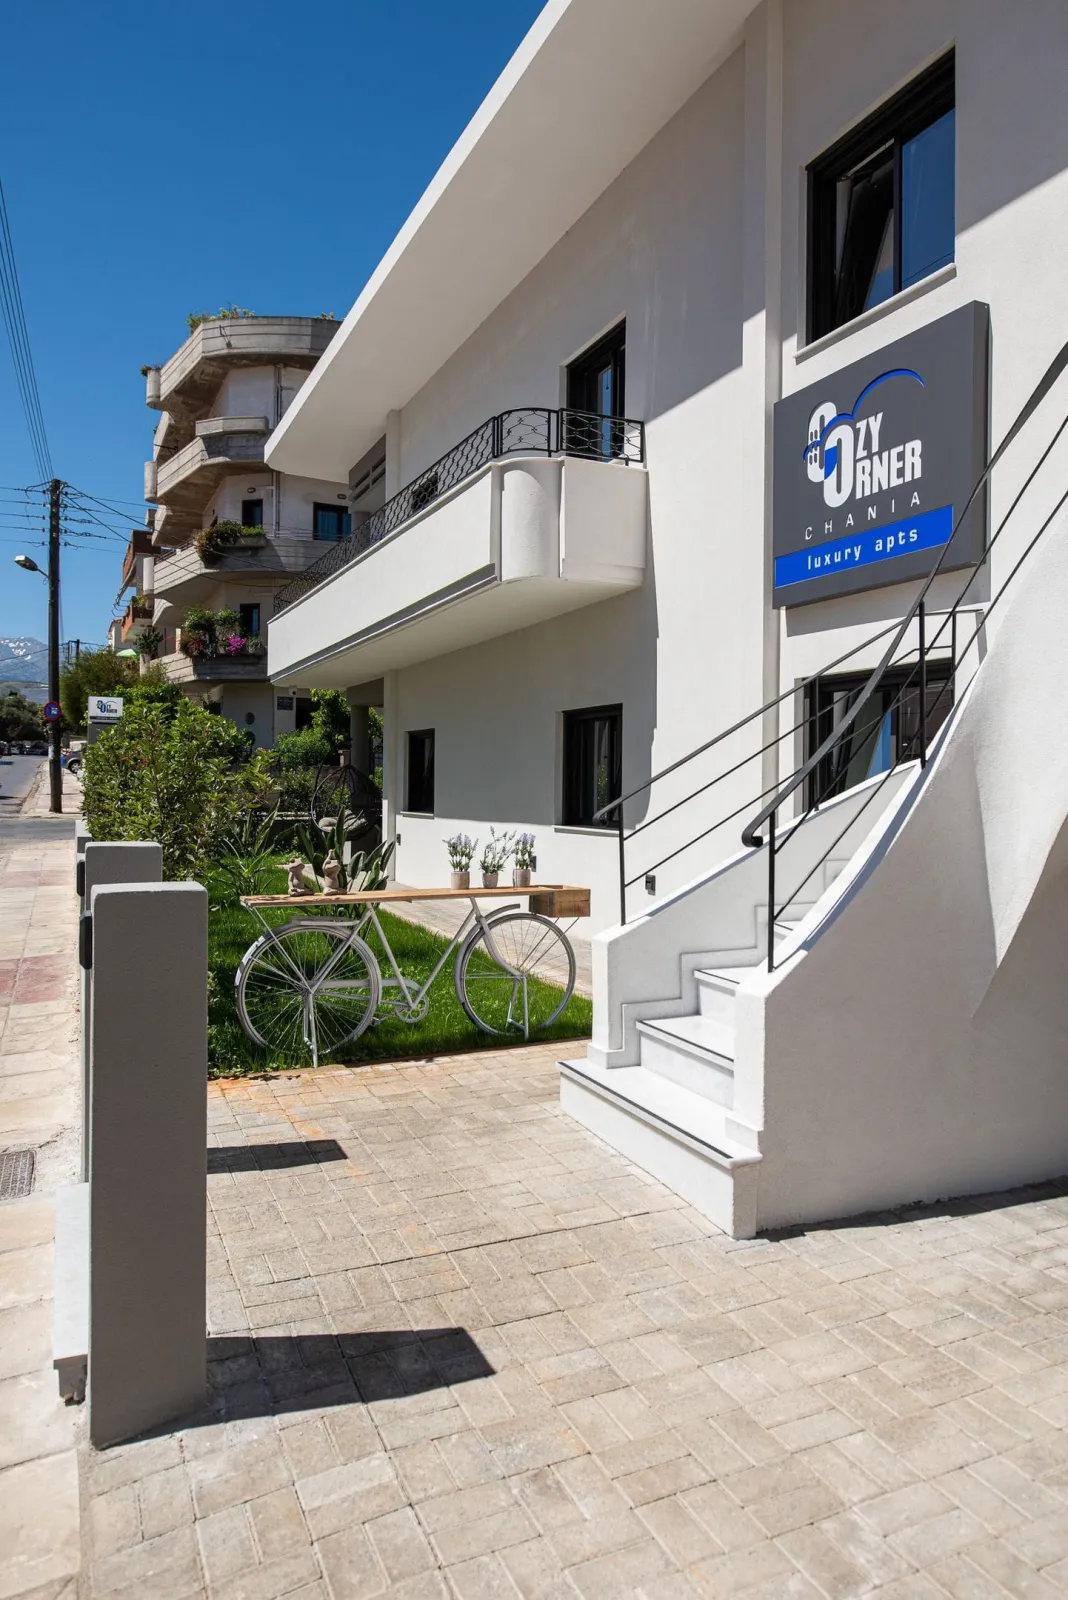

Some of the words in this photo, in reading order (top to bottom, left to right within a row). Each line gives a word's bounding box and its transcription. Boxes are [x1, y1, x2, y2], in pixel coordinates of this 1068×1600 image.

[805, 491, 920, 540] CHANIA
[808, 545, 861, 570] luxury
[875, 529, 918, 552] apts
